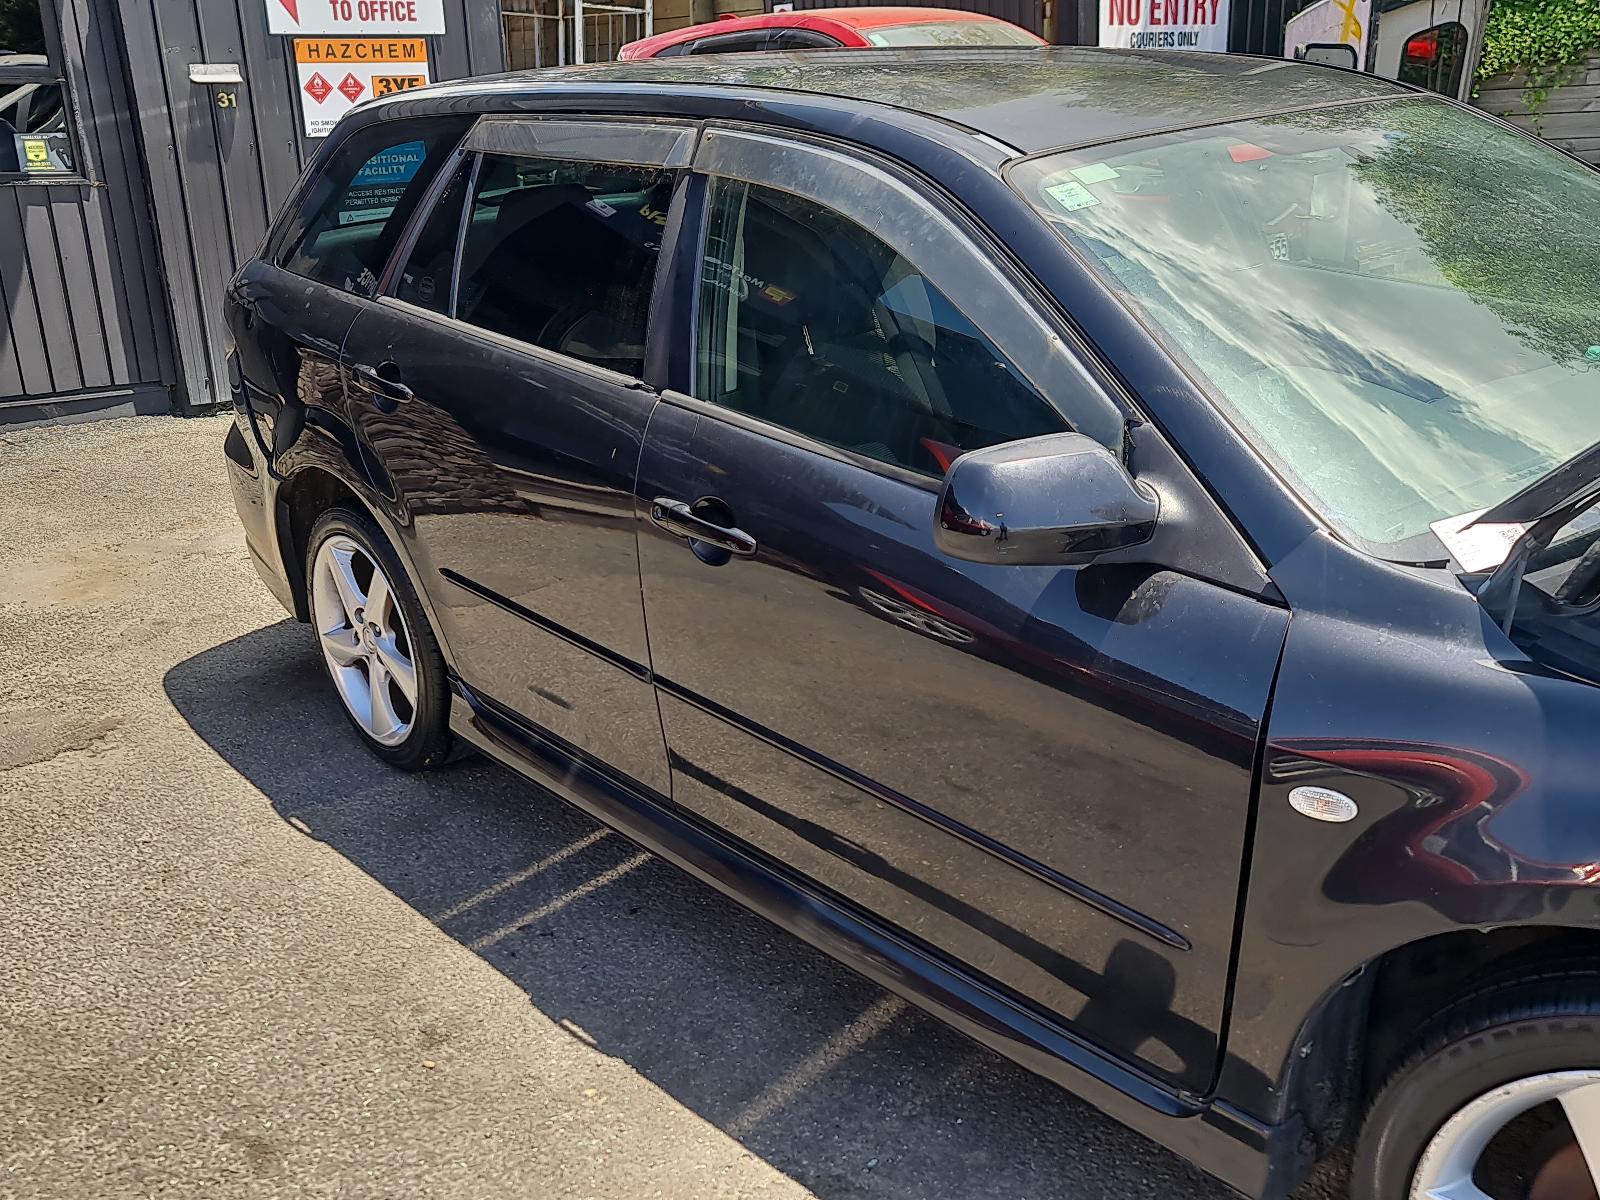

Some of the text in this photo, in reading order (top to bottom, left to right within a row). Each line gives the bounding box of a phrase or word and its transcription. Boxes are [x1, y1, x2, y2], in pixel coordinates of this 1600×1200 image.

[329, 0, 417, 21] TO OFFICE
[1108, 0, 1219, 25] NO ENTRY
[1130, 31, 1199, 48] COURIERS ONLY
[307, 43, 416, 58] HAZCHEM
[217, 92, 236, 108] 31
[359, 164, 406, 176] FACILITY
